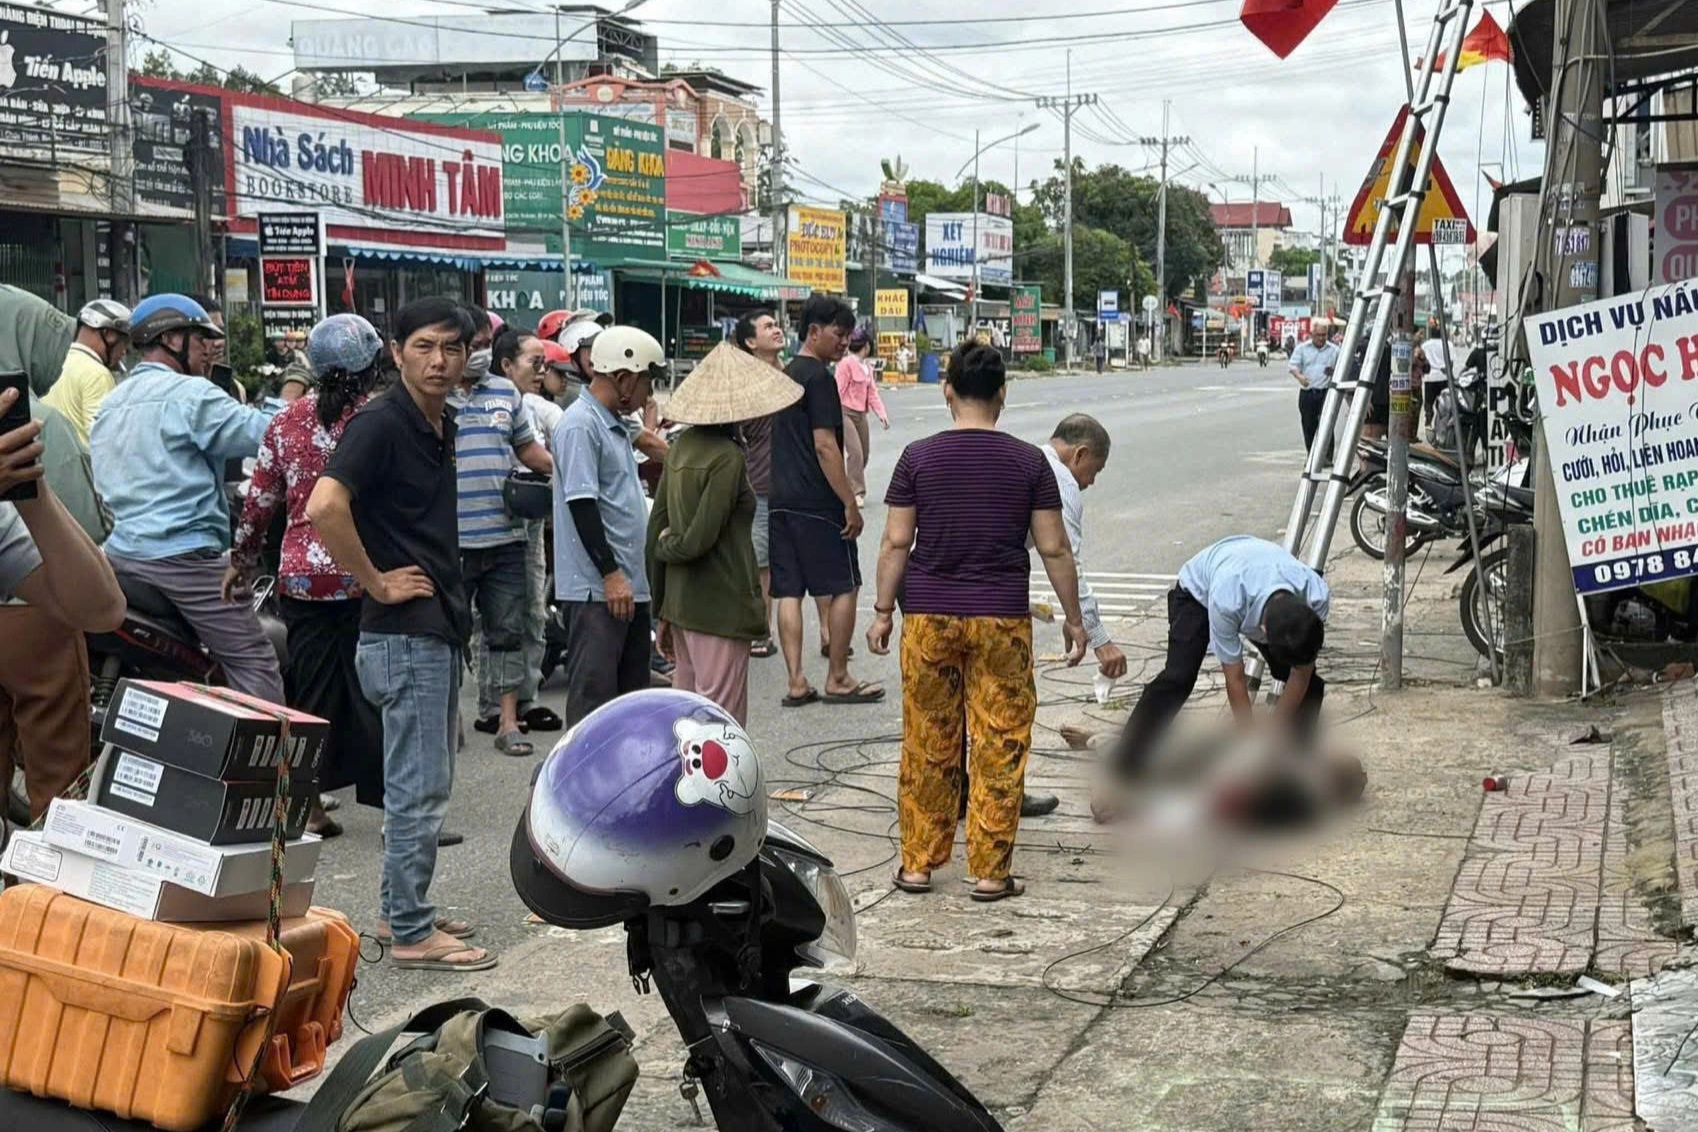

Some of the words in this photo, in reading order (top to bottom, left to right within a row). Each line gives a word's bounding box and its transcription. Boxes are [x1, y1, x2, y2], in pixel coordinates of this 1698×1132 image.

[26, 10, 48, 29] ĐIỆN
[49, 15, 76, 34] THOẠI
[24, 54, 60, 80] Tiến
[61, 62, 106, 90] Apple
[242, 126, 291, 171] Nhà
[297, 132, 354, 176] Sách
[502, 142, 525, 164] NG
[528, 142, 577, 164] KHOA
[606, 141, 635, 173] ĐĂNG
[638, 151, 665, 178] KHOA
[246, 175, 353, 203] BOOKSTORE
[361, 149, 437, 214] MINH
[442, 149, 501, 218] TÂM
[292, 226, 315, 238] Apple
[943, 217, 963, 241] XÉT
[1434, 219, 1455, 230] TAXI
[790, 240, 834, 256] PHOTOCOPY
[932, 244, 976, 269] NGHIỆM
[276, 276, 298, 286] ATM
[580, 274, 604, 287] PHẨM
[594, 289, 609, 301] TÓC
[1539, 311, 1603, 347] DỊCH
[1608, 301, 1645, 331] VỤ
[1549, 343, 1668, 408] NGỌC
[1565, 423, 1622, 447] Nhận
[1628, 411, 1683, 438] Phục
[1562, 454, 1600, 483] CƯỚI,
[1601, 446, 1631, 476] HỎI,
[1632, 443, 1664, 469] LIÊN
[1570, 487, 1607, 509] CHO
[1611, 474, 1658, 501] THUÊ
[1662, 469, 1698, 492] RẠP
[1577, 509, 1633, 535] CHÉN
[1581, 535, 1606, 558] CÓ
[1612, 529, 1651, 552] BAN
[1657, 521, 1698, 543] NHẠ
[1594, 554, 1665, 584] 0978
